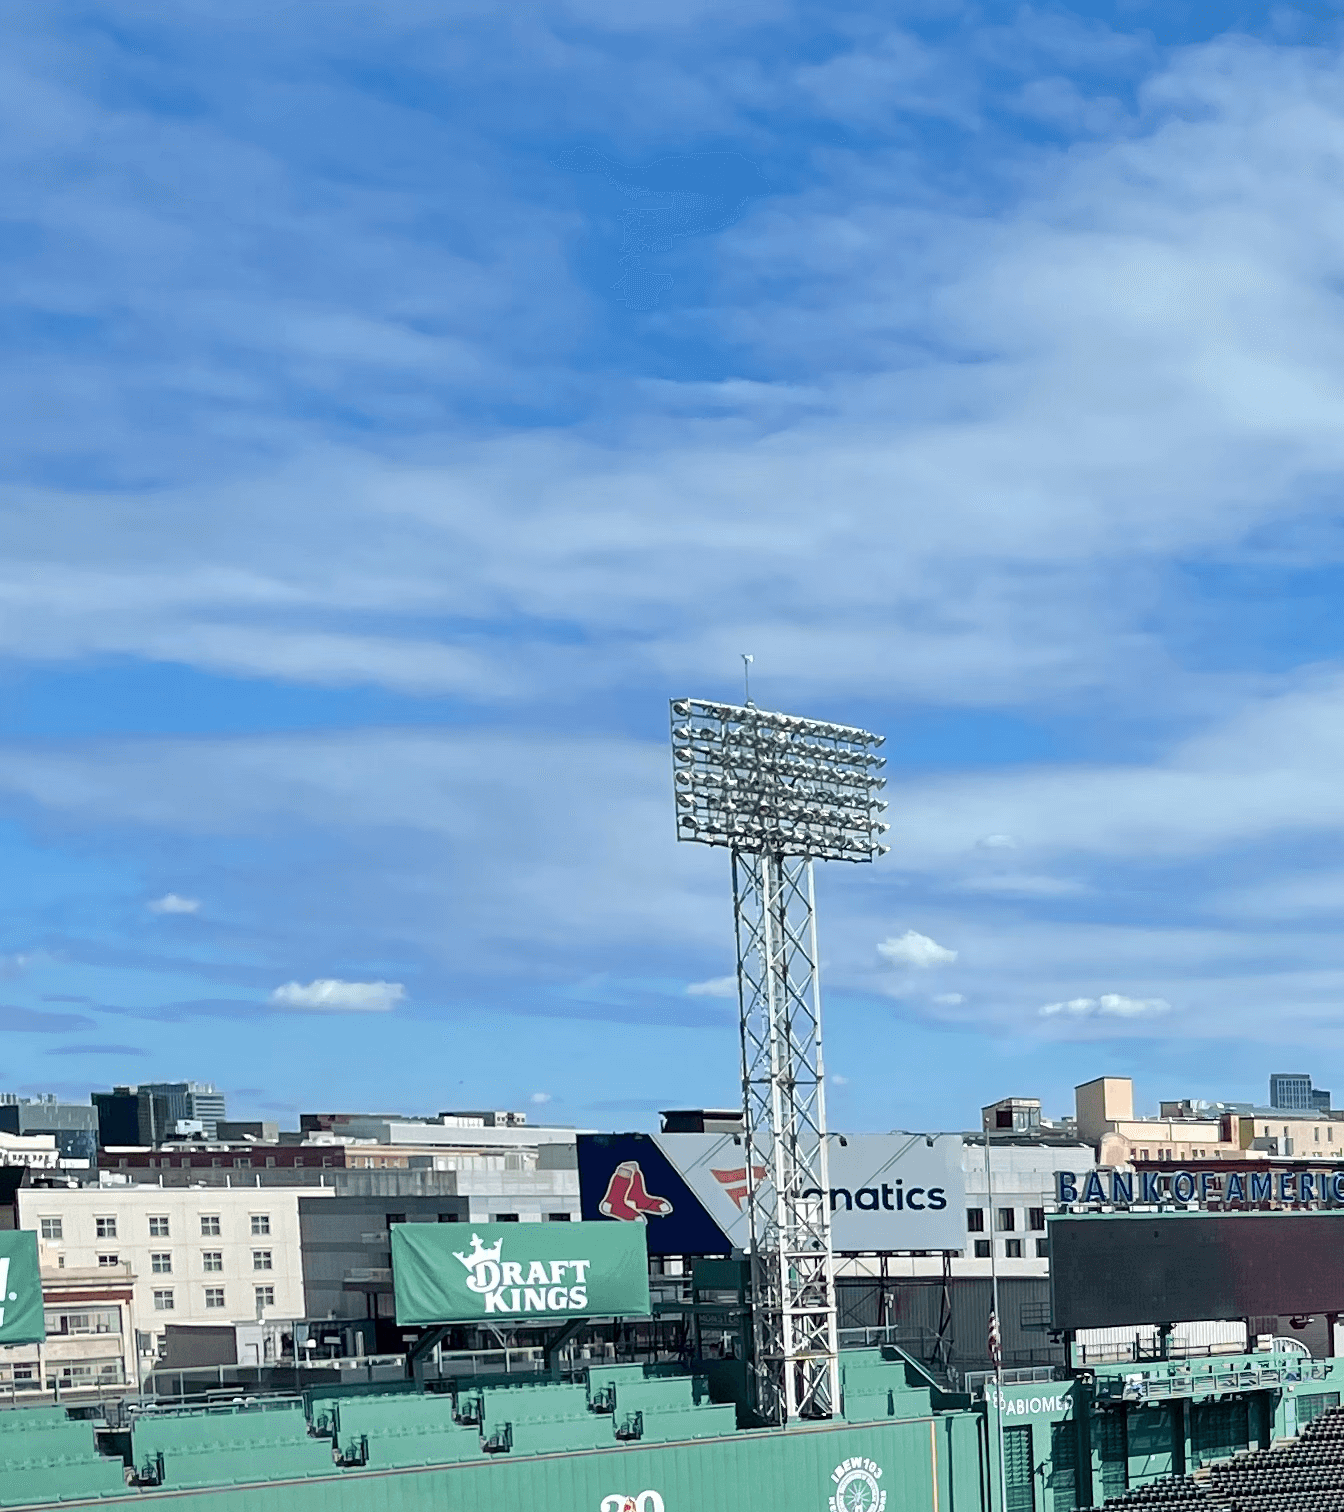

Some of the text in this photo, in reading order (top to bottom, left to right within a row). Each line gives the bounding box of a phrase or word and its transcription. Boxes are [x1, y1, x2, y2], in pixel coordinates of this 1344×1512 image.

[786, 1178, 948, 1211] natics
[1055, 1170, 1158, 1203] BANK
[1173, 1170, 1215, 1203] OF
[466, 1259, 591, 1293] DRAFT
[484, 1285, 588, 1314] KINGS
[1005, 1394, 1074, 1416] ABIOMED
[862, 1458, 884, 1480] 103
